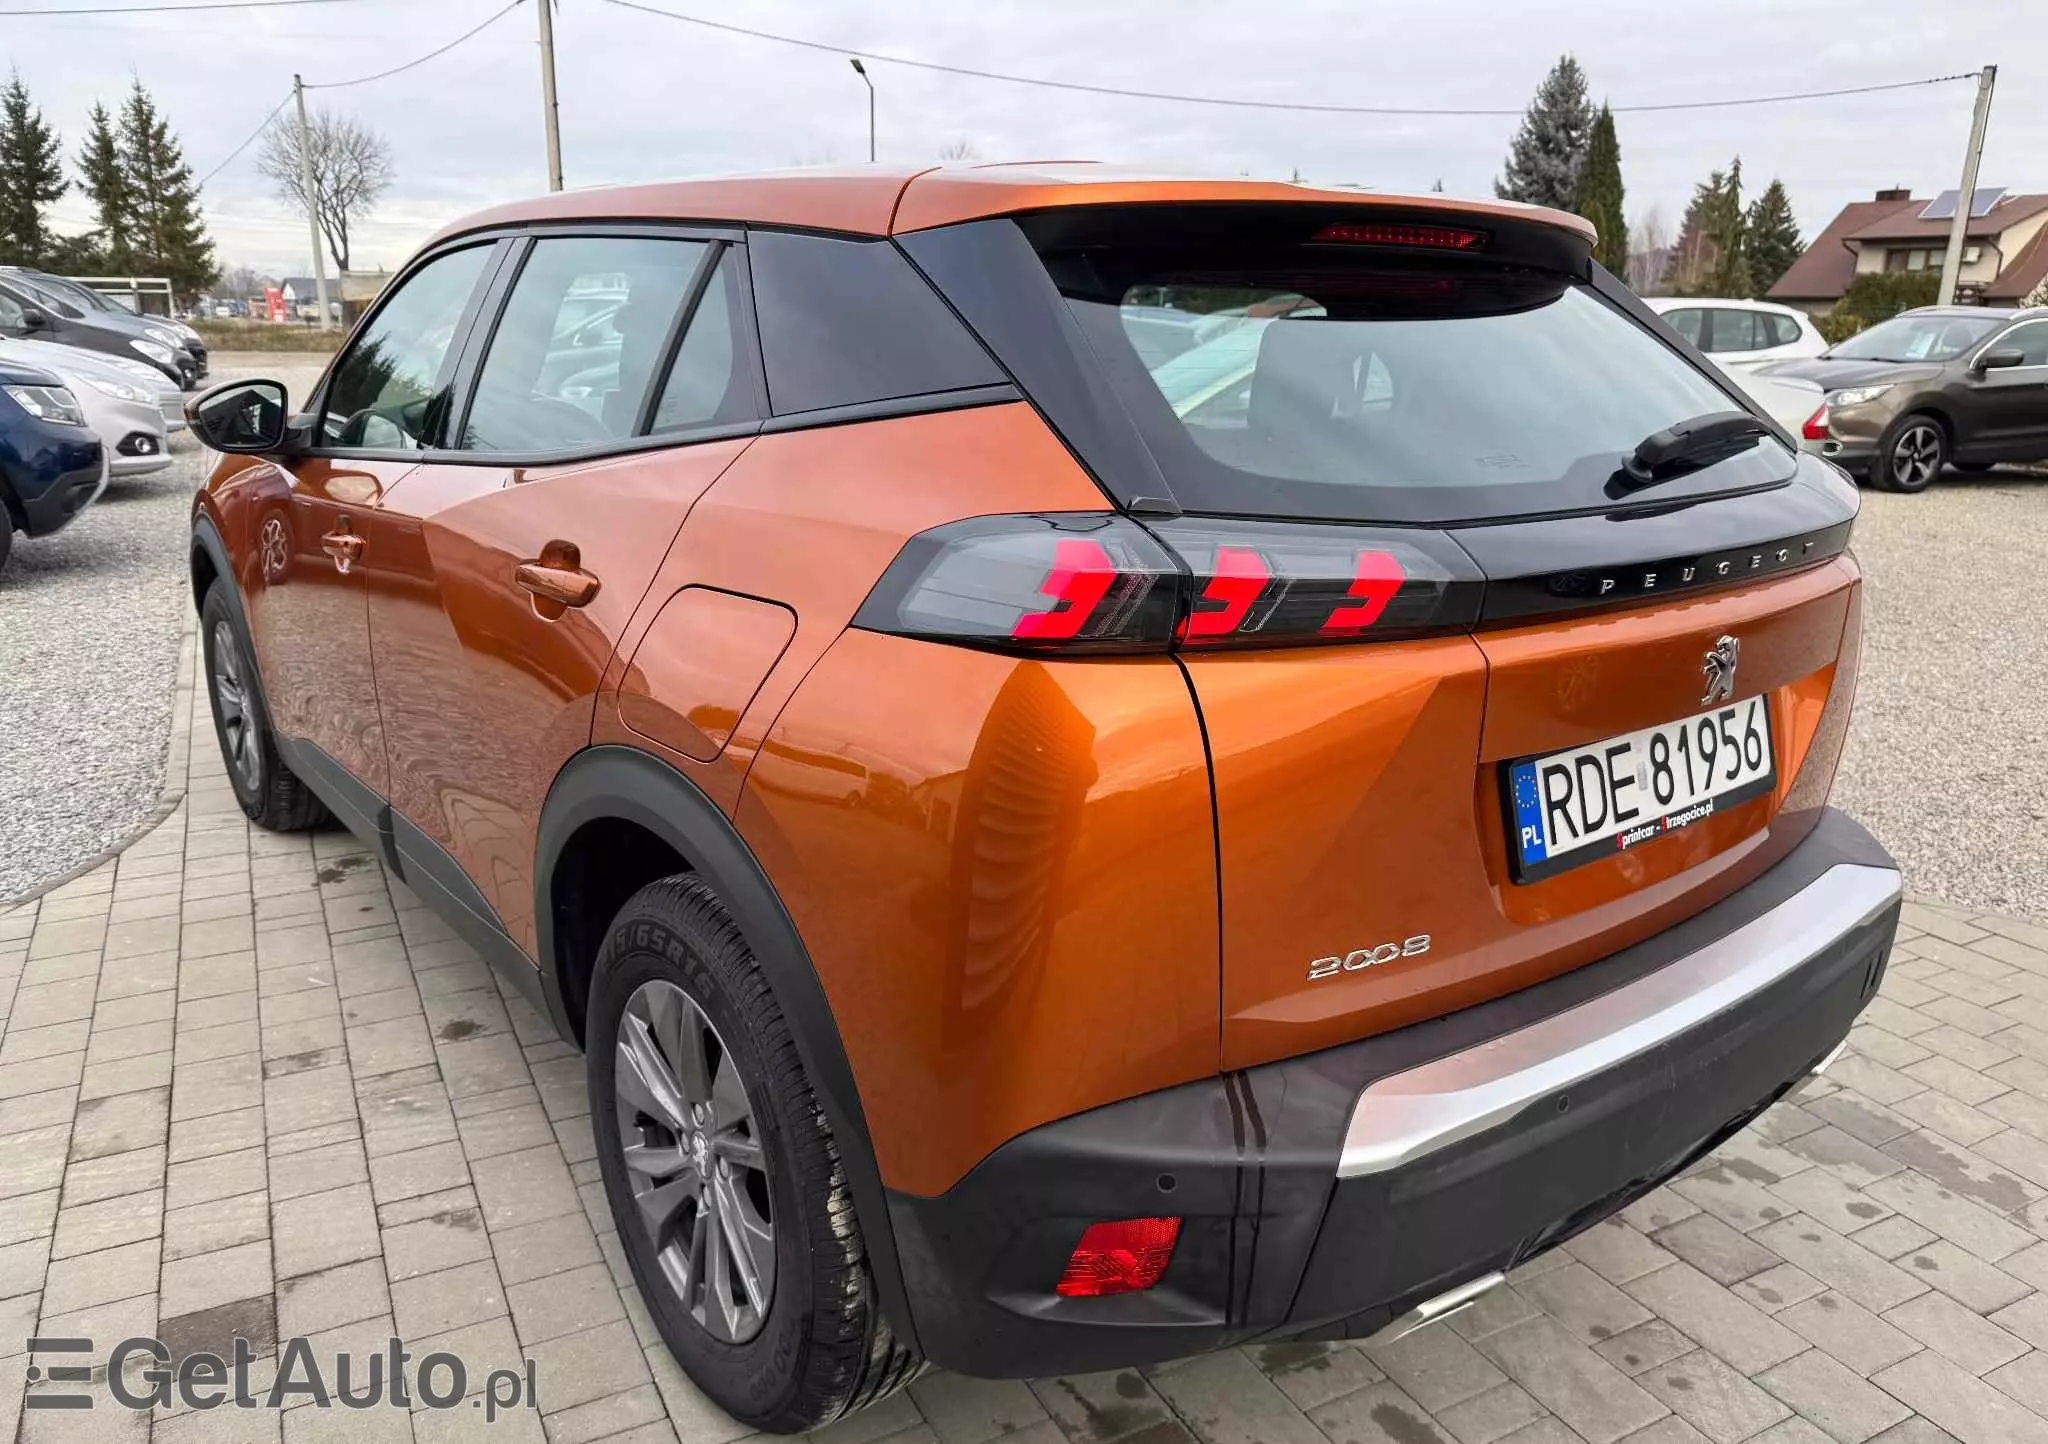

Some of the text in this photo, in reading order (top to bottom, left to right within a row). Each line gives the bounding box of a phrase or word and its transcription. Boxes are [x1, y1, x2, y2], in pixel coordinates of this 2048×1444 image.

[1601, 542, 1815, 594] PEUGEOT
[1542, 701, 1763, 846] RDE 81956
[1522, 826, 1542, 849] PL
[1306, 934, 1431, 982] 2008
